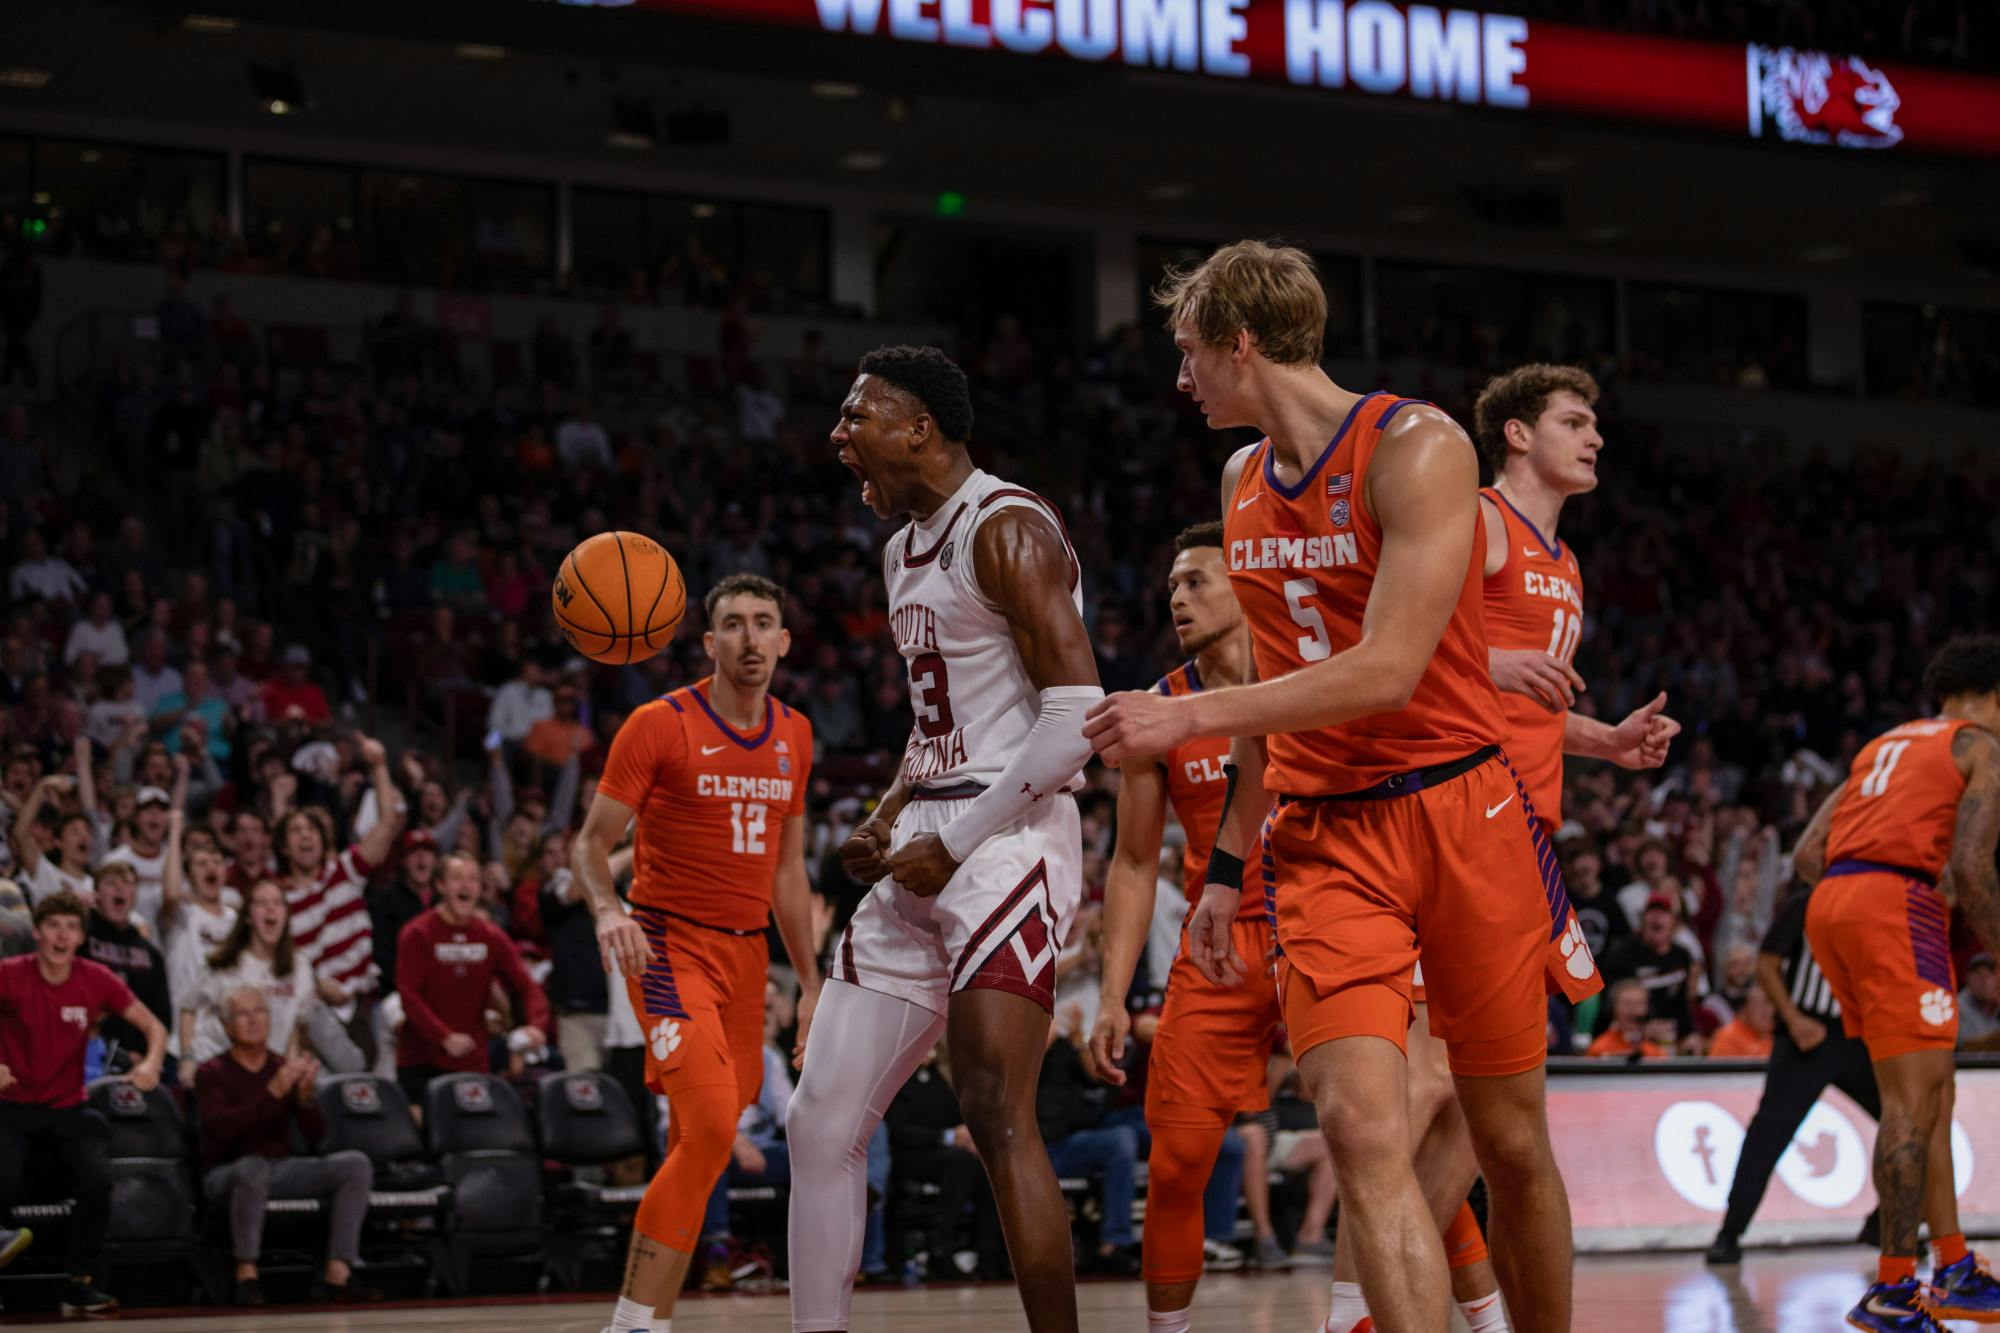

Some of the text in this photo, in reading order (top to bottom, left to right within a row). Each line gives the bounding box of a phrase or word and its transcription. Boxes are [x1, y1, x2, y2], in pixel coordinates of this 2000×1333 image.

[1285, 0, 1530, 108] HOME
[1230, 532, 1359, 571] CLEMSON
[1283, 577, 1333, 662] 5
[697, 773, 793, 802] CLEMSON
[1860, 738, 1912, 798] 11
[730, 802, 769, 855] 12
